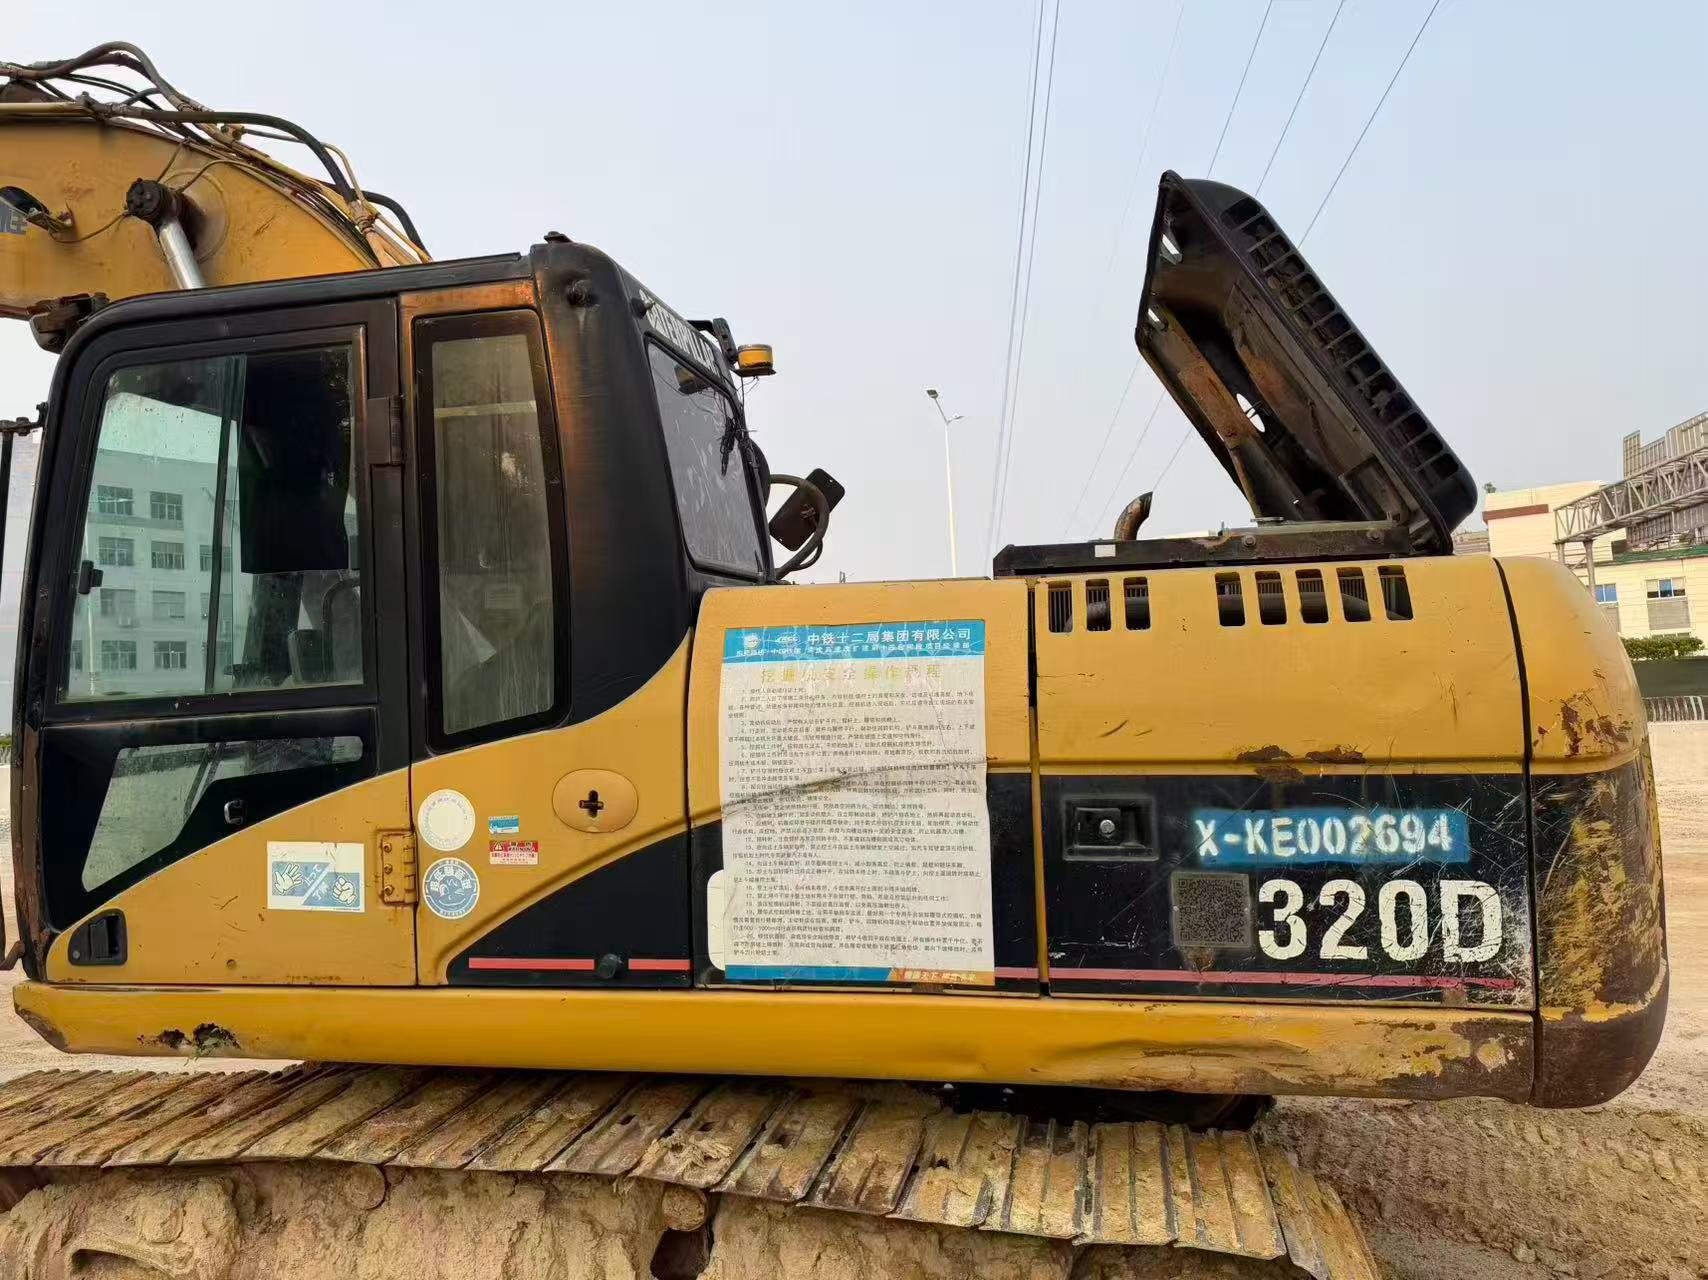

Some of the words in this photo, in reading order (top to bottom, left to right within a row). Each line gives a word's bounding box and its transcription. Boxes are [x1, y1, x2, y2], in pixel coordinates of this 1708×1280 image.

[807, 628, 971, 645] 中铁十二局集团有限公司
[1195, 814, 1452, 857] X-KE002694
[1258, 878, 1503, 963] 320D
